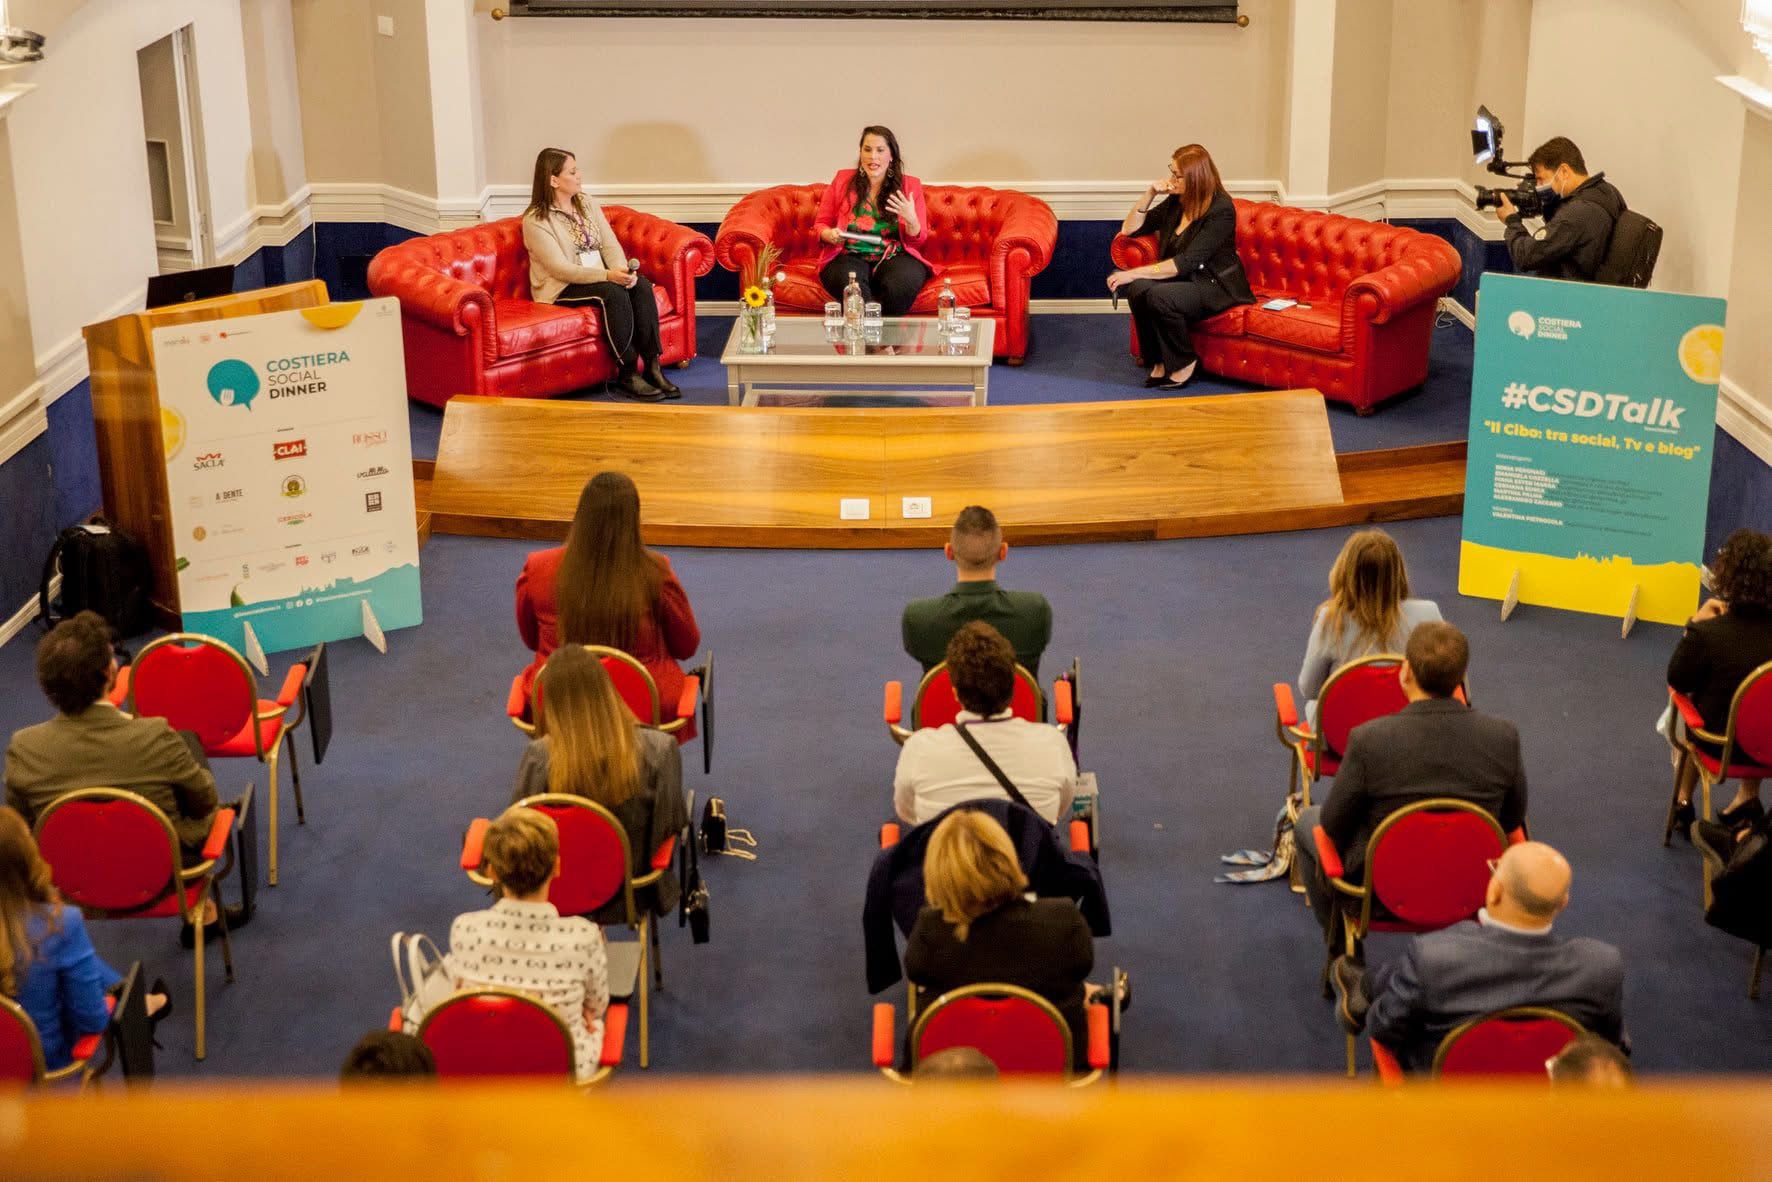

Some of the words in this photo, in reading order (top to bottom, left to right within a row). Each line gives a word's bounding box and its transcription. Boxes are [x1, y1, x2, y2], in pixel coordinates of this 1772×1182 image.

[1538, 316, 1582, 329] COSTIERA
[266, 350, 351, 373] COSTIERA
[267, 369, 322, 387] SOCIAL
[269, 381, 327, 400] DINNER
[1501, 382, 1687, 430] #CSDTalk
[1503, 423, 1542, 440] Cibo:
[1545, 428, 1568, 443] tra
[1571, 433, 1620, 450] social,
[1623, 437, 1642, 452] Tv
[1645, 442, 1655, 454] e
[277, 443, 303, 456] CLAI
